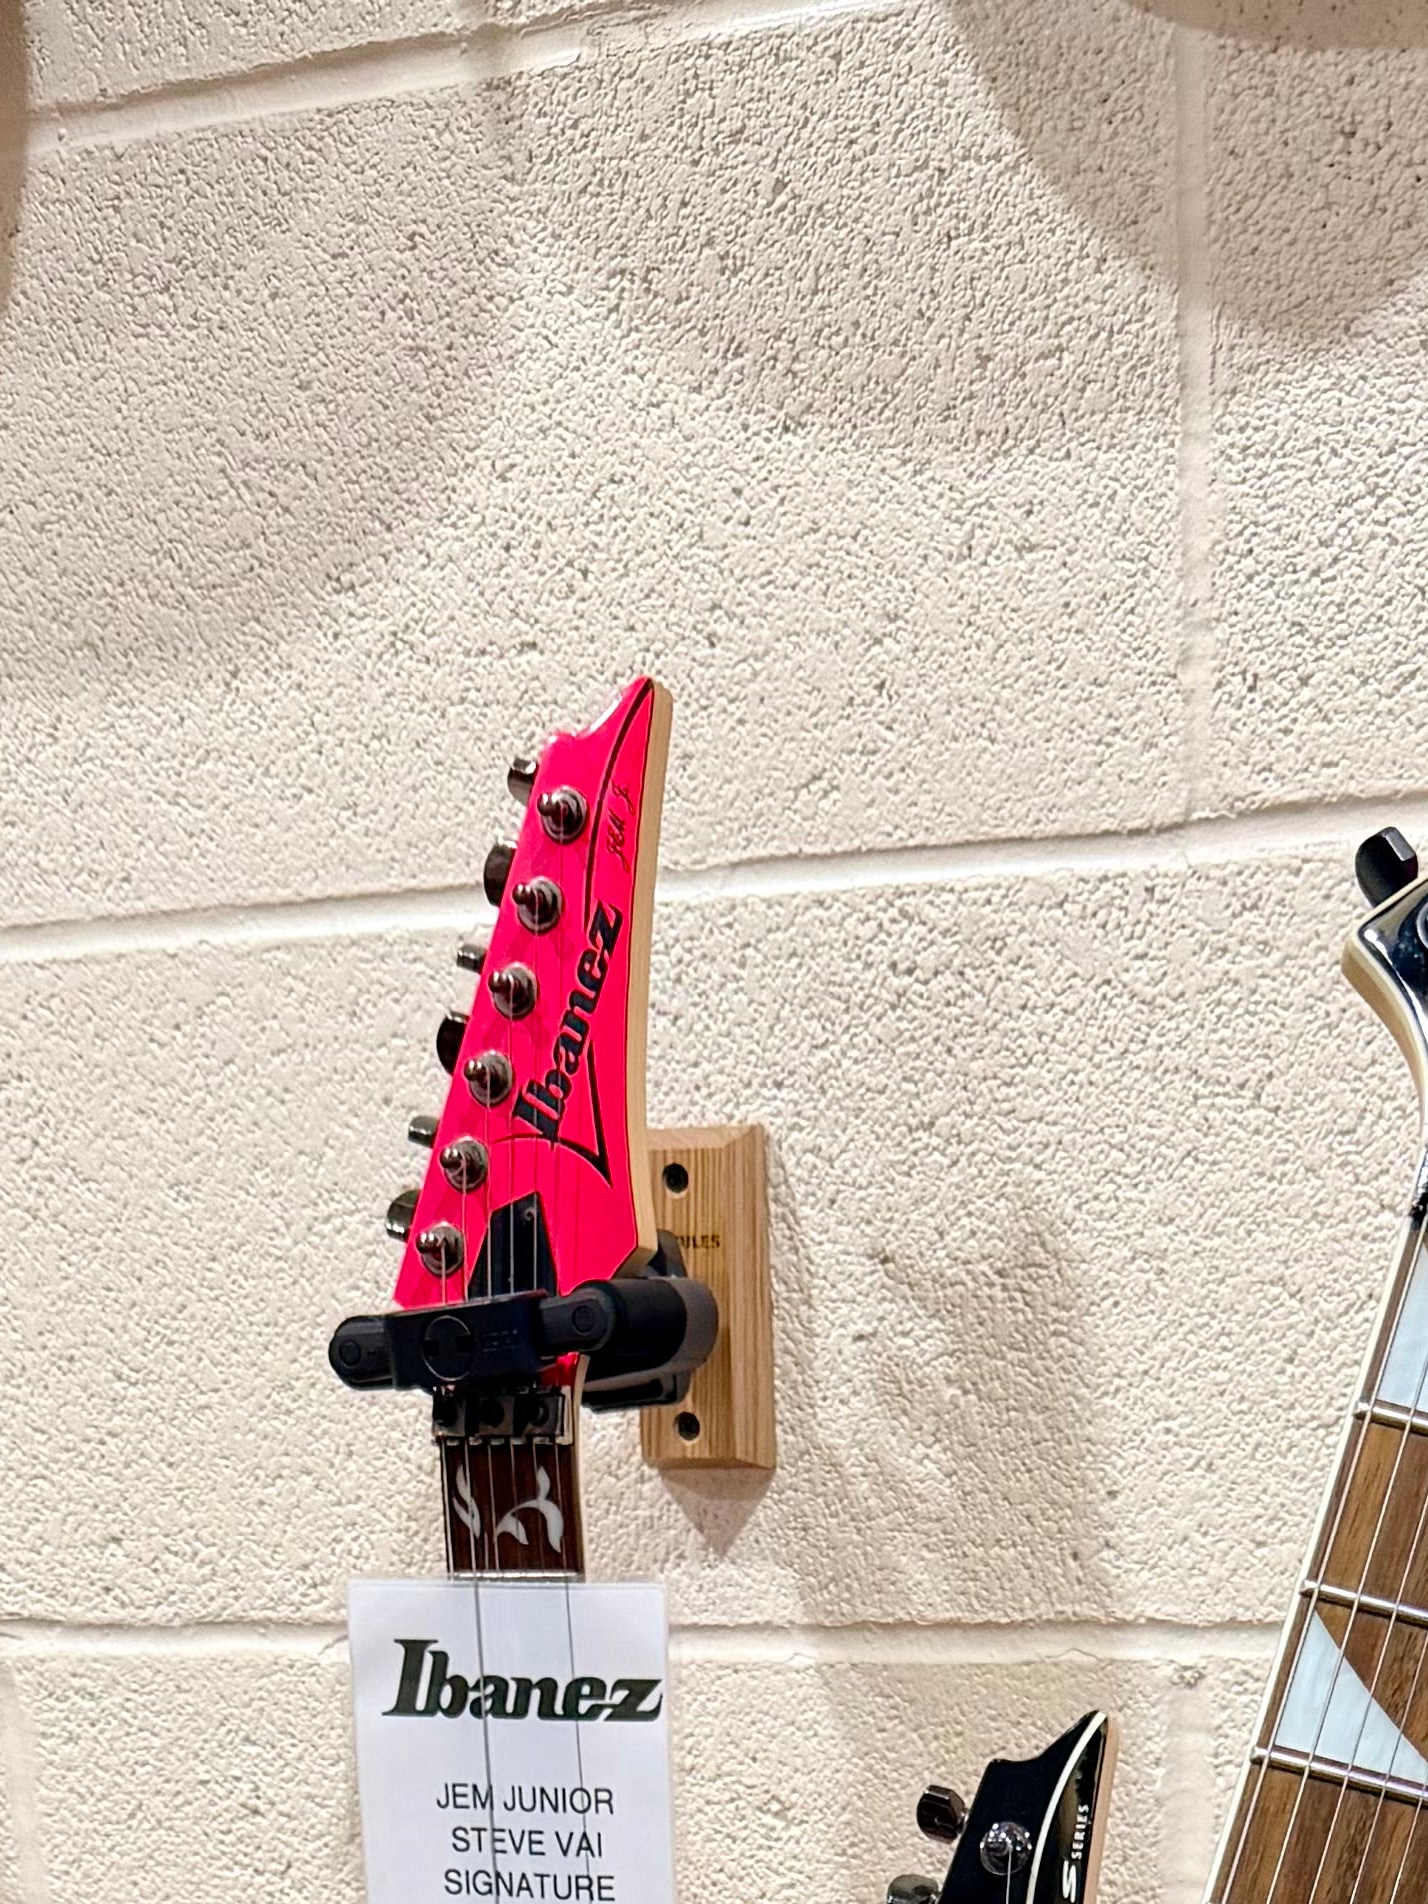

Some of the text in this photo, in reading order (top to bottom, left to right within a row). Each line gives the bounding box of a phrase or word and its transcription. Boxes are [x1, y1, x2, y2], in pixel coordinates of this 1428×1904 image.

[510, 899, 624, 1147] Ibanez
[381, 1637, 664, 1722] Ibanez
[436, 1782, 614, 1815] JEM JUNIOR
[451, 1825, 603, 1858] STEVE VAI
[1071, 1803, 1090, 1860] SERIES
[443, 1868, 616, 1902] SIGNATURE
